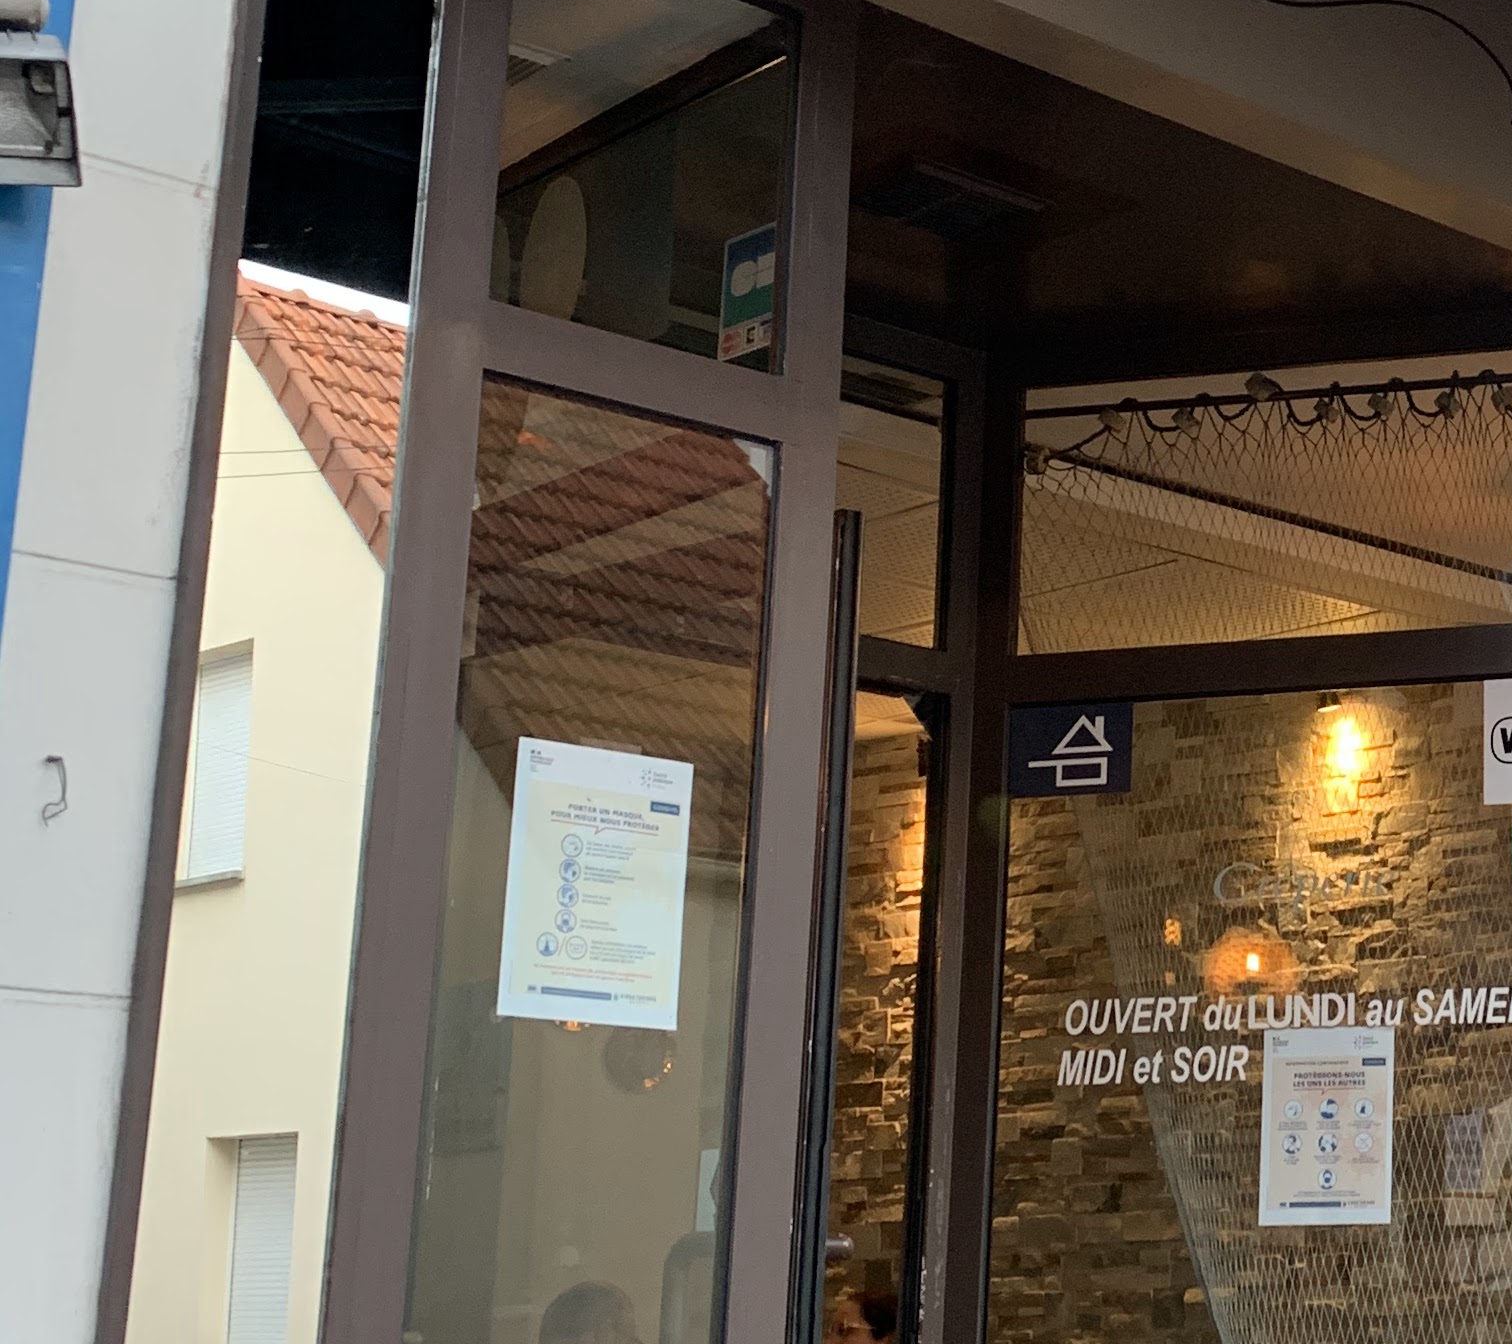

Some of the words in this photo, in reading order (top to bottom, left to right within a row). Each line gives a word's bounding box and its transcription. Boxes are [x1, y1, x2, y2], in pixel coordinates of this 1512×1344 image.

[1065, 995, 1197, 1036] OUVERT
[1203, 998, 1242, 1032] du
[1248, 992, 1356, 1030] LUNDI
[1365, 998, 1403, 1028] au
[1057, 1049, 1125, 1087] MIDI
[1132, 1058, 1164, 1084] et
[1170, 1045, 1249, 1083] SOIR
